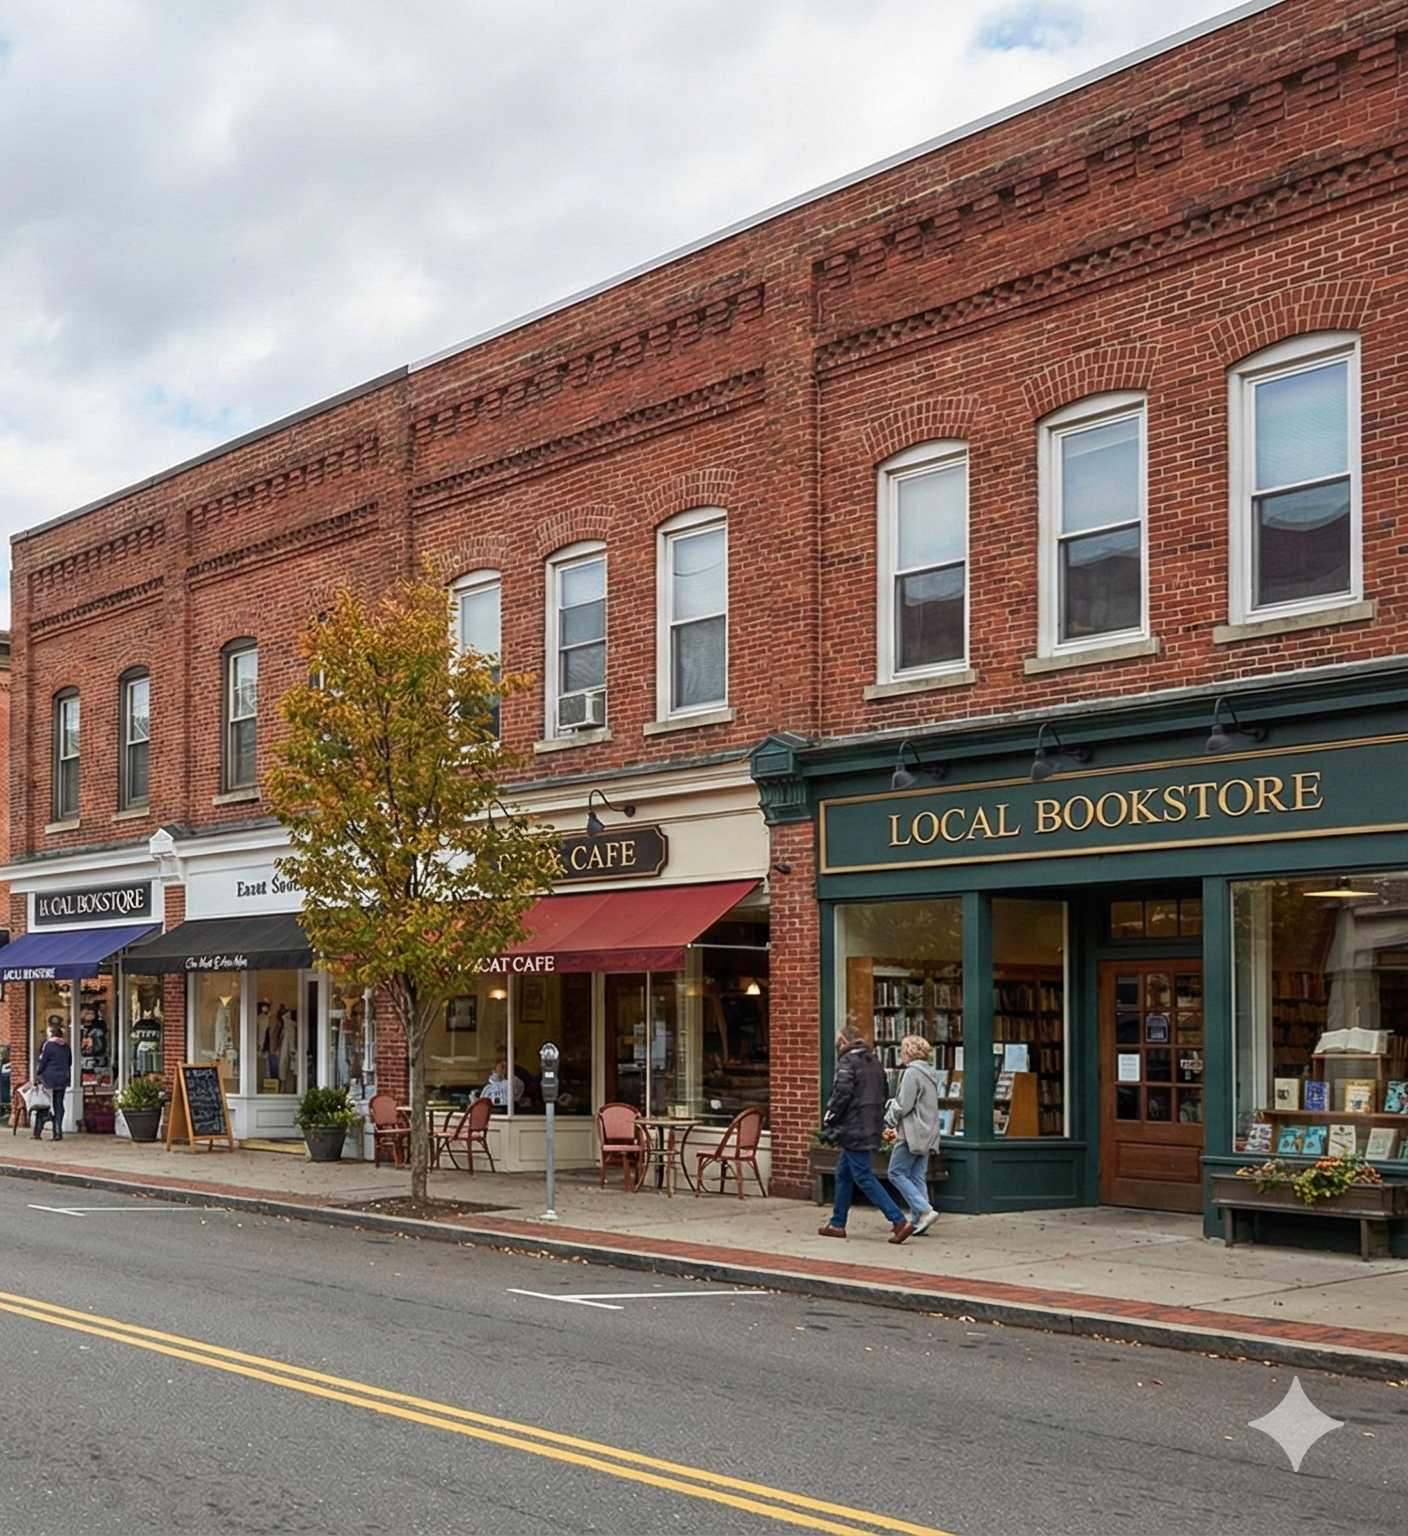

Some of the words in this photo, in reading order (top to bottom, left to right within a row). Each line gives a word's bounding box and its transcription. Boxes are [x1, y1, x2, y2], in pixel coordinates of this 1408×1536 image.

[888, 802, 1022, 847] LOCAL
[1033, 771, 1324, 834] BOOKSTORE
[570, 840, 637, 871] CAFE
[472, 957, 511, 973] CAT
[512, 955, 555, 972] CAFE
